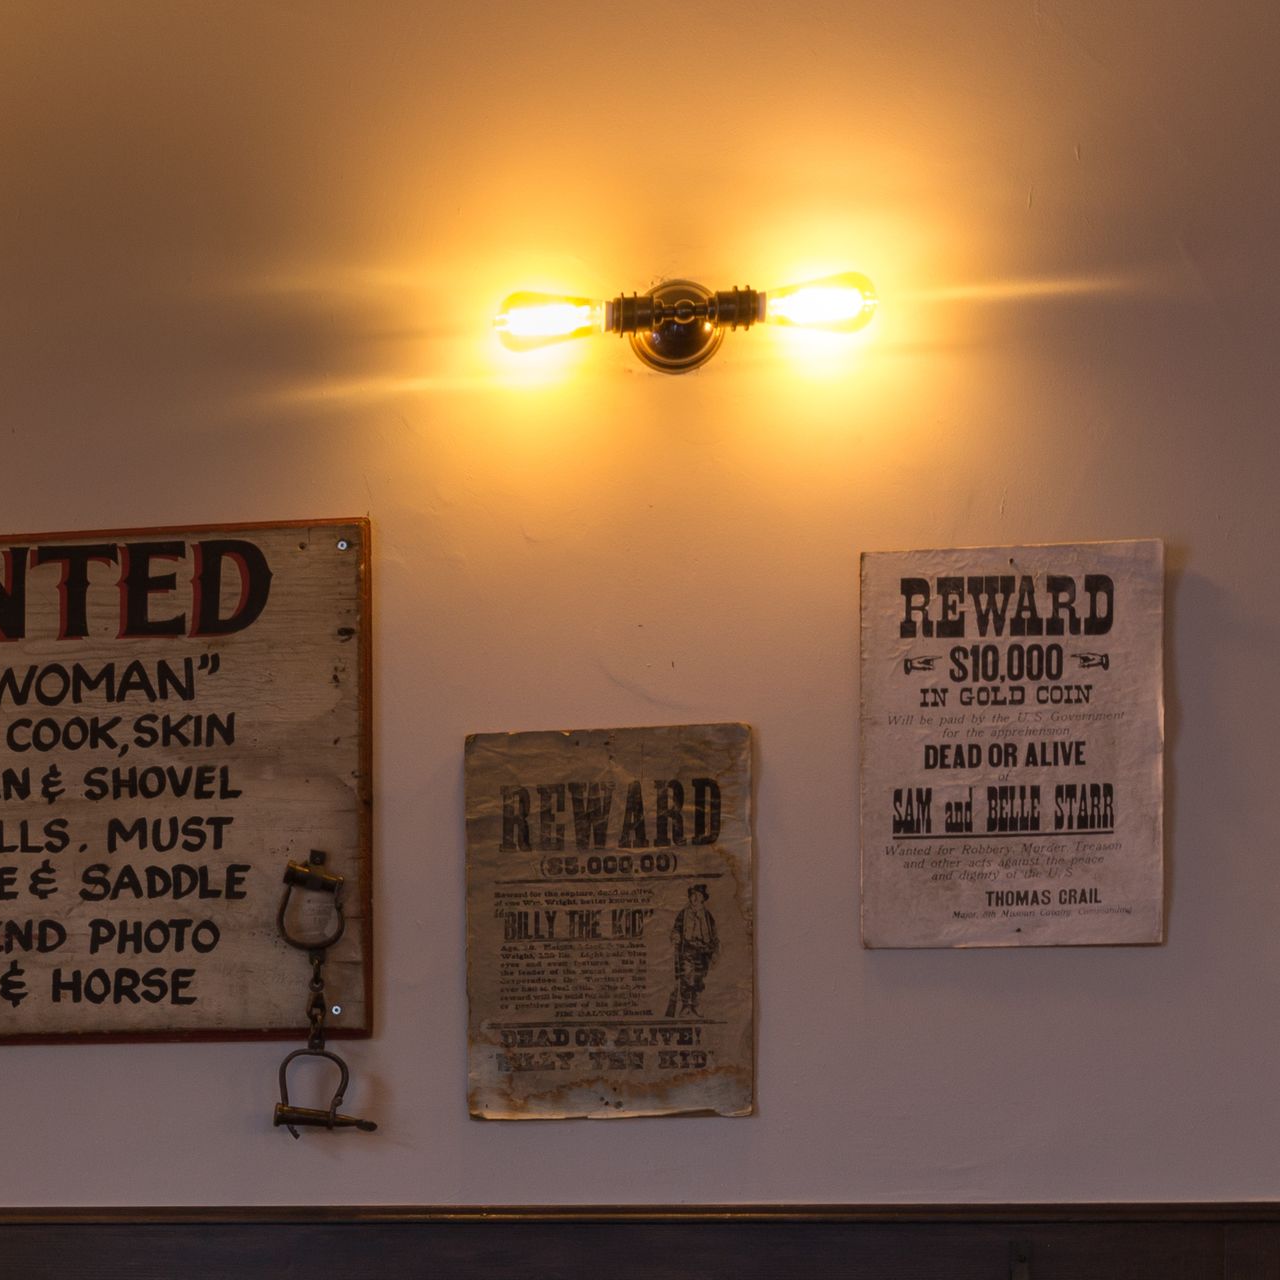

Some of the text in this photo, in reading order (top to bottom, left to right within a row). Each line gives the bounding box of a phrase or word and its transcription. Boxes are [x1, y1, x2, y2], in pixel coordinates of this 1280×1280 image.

[900, 574, 1114, 638] REWARD
[949, 644, 1063, 683] $10,000
[920, 685, 1092, 707] IN GOLD COIN
[134, 711, 235, 748] SKIN
[888, 714, 913, 725] Will
[920, 715, 933, 724] be
[939, 714, 965, 727] paid
[971, 714, 986, 725] by
[992, 713, 1010, 723] the
[1050, 711, 1127, 722] Government
[942, 728, 960, 738] for
[967, 727, 984, 738] the
[924, 741, 1086, 770] DEAD OR ALIVE
[42, 764, 65, 804] &
[84, 765, 241, 799] SHOVEL
[998, 771, 1010, 782] of
[499, 777, 722, 852] REWARD
[893, 783, 1114, 834] SAM and BELLE STARR
[107, 816, 233, 851] MUST
[885, 844, 931, 856] Wanted
[938, 846, 955, 855] for
[903, 859, 924, 868] and
[931, 858, 961, 868] other
[968, 857, 991, 866] acts
[998, 856, 1040, 868] against
[1046, 856, 1065, 865] the
[30, 860, 57, 900] &
[79, 864, 250, 900] SADDLE
[931, 871, 952, 881] and
[959, 870, 999, 881] dignity
[1024, 868, 1041, 878] the
[985, 888, 1101, 907] THOMAS CRAIL
[89, 919, 220, 953] PHOTO
[565, 910, 601, 938] THE
[0, 960, 28, 1007] &
[51, 967, 197, 1005] HORSE
[501, 1027, 701, 1048] DEAD OR ALIVE!
